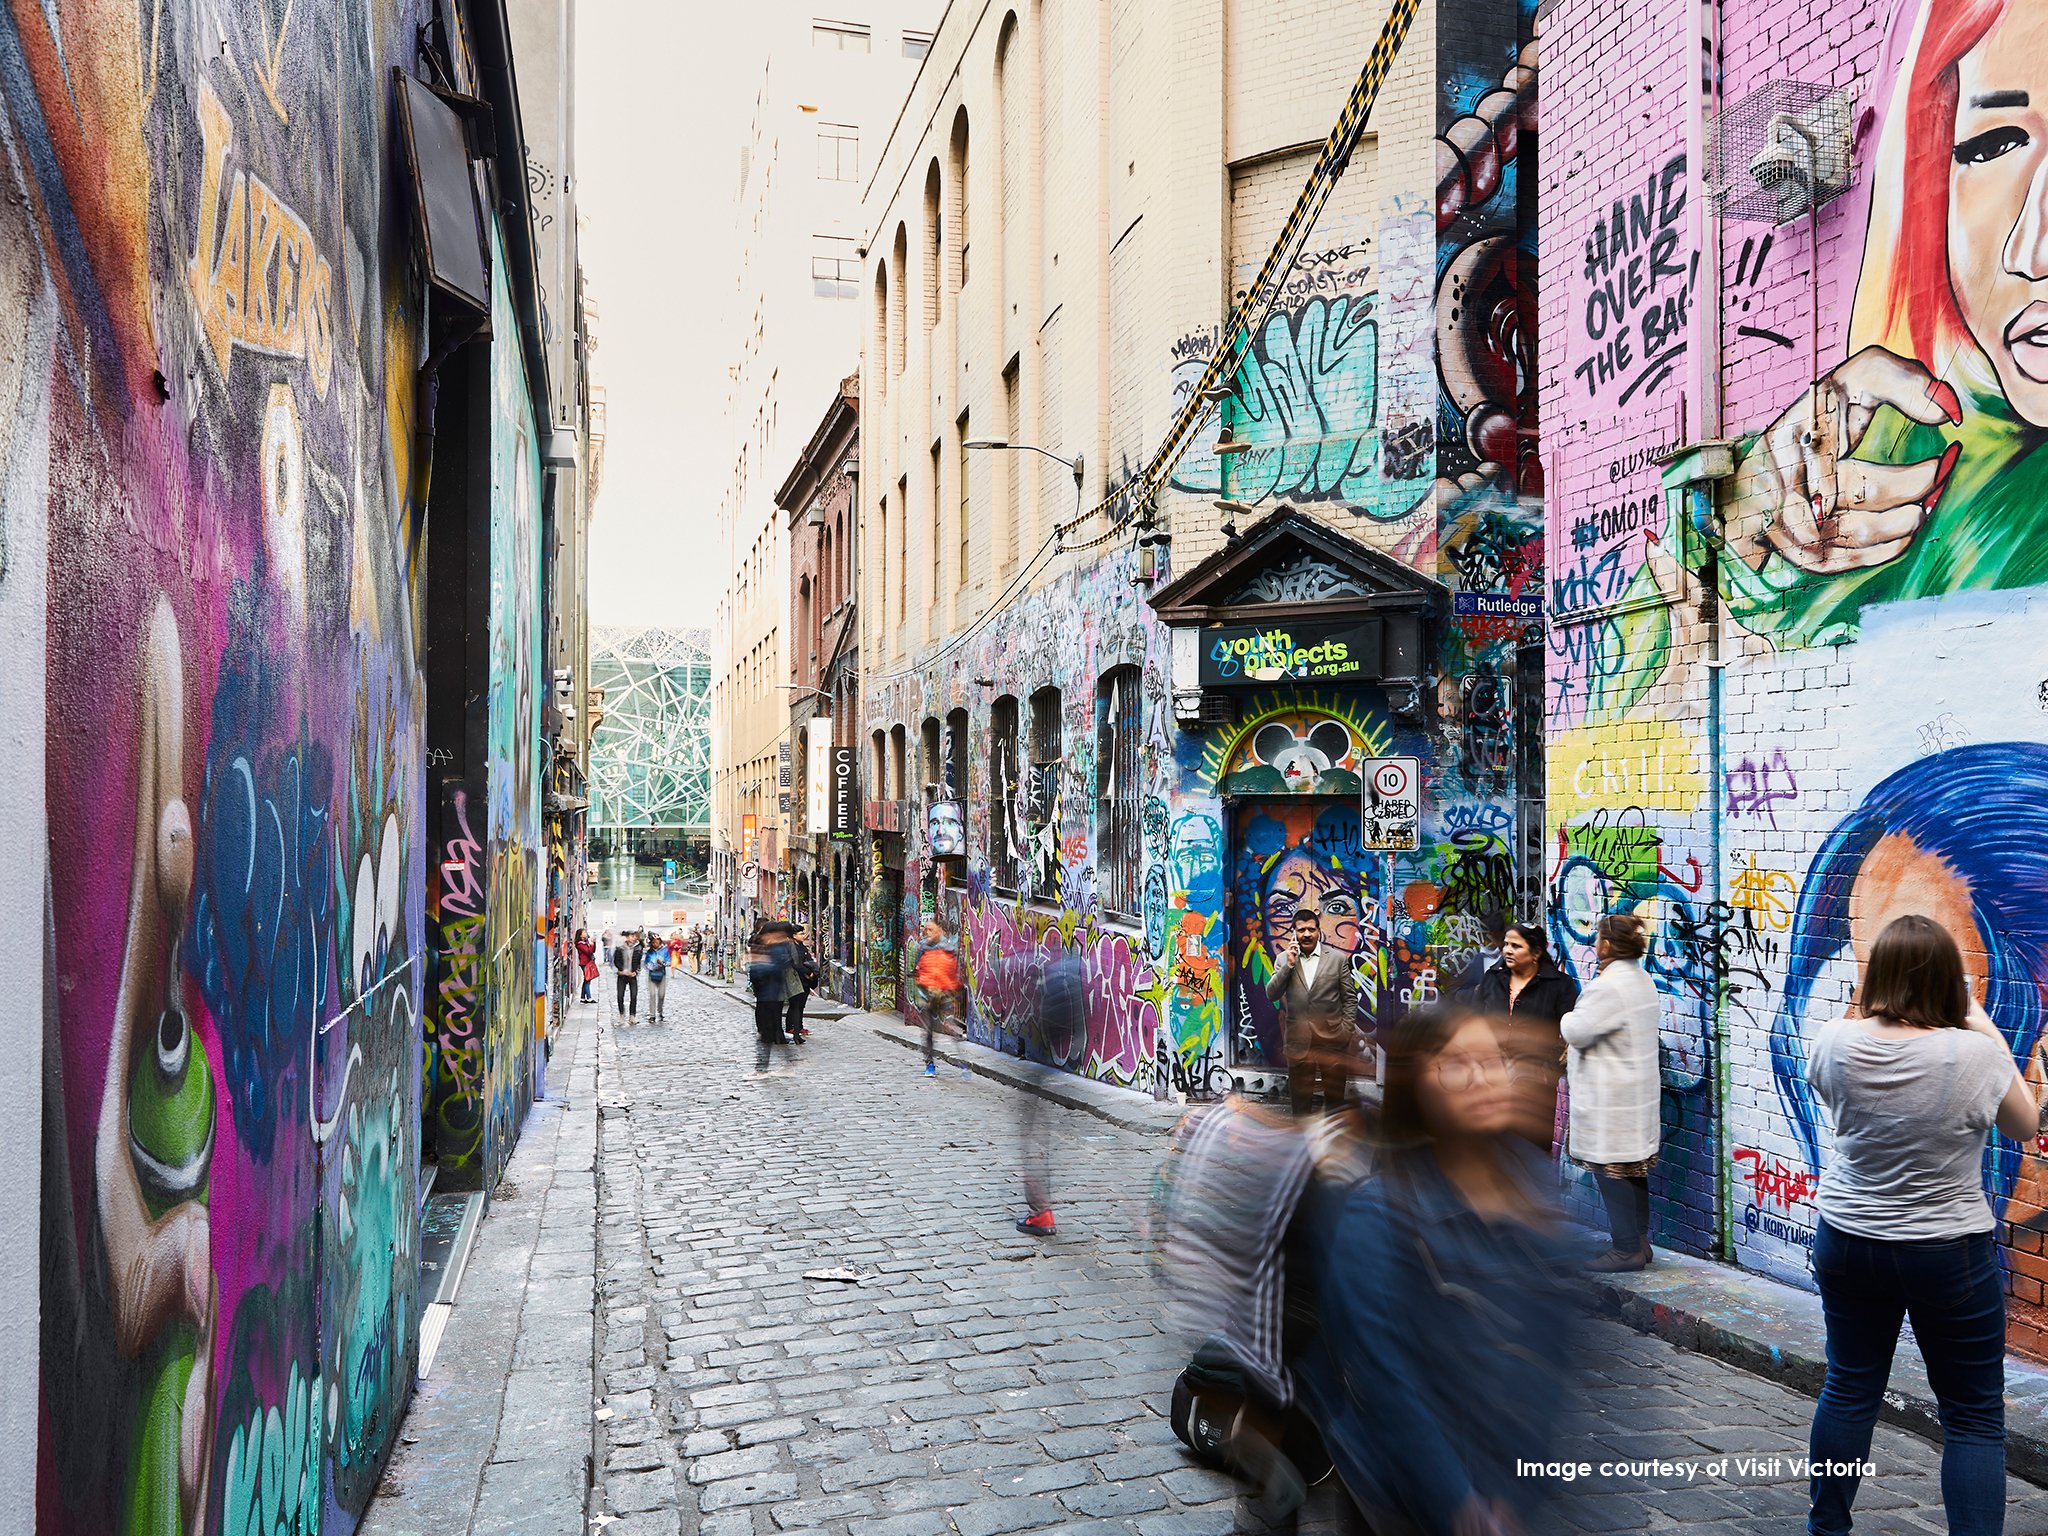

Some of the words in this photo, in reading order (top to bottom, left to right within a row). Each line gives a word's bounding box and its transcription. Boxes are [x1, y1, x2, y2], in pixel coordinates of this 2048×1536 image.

[190, 76, 333, 401] LAKERS
[1584, 154, 1687, 286] HAND
[1586, 228, 1687, 341] OVER
[1575, 325, 1633, 397] THE
[1477, 597, 1537, 616] Rutledge
[1220, 628, 1292, 662] youth
[1311, 660, 1360, 677] .org.au
[835, 750, 851, 829] COFFEE
[1371, 799, 1411, 809] HARED
[1383, 773, 1399, 788] 10
